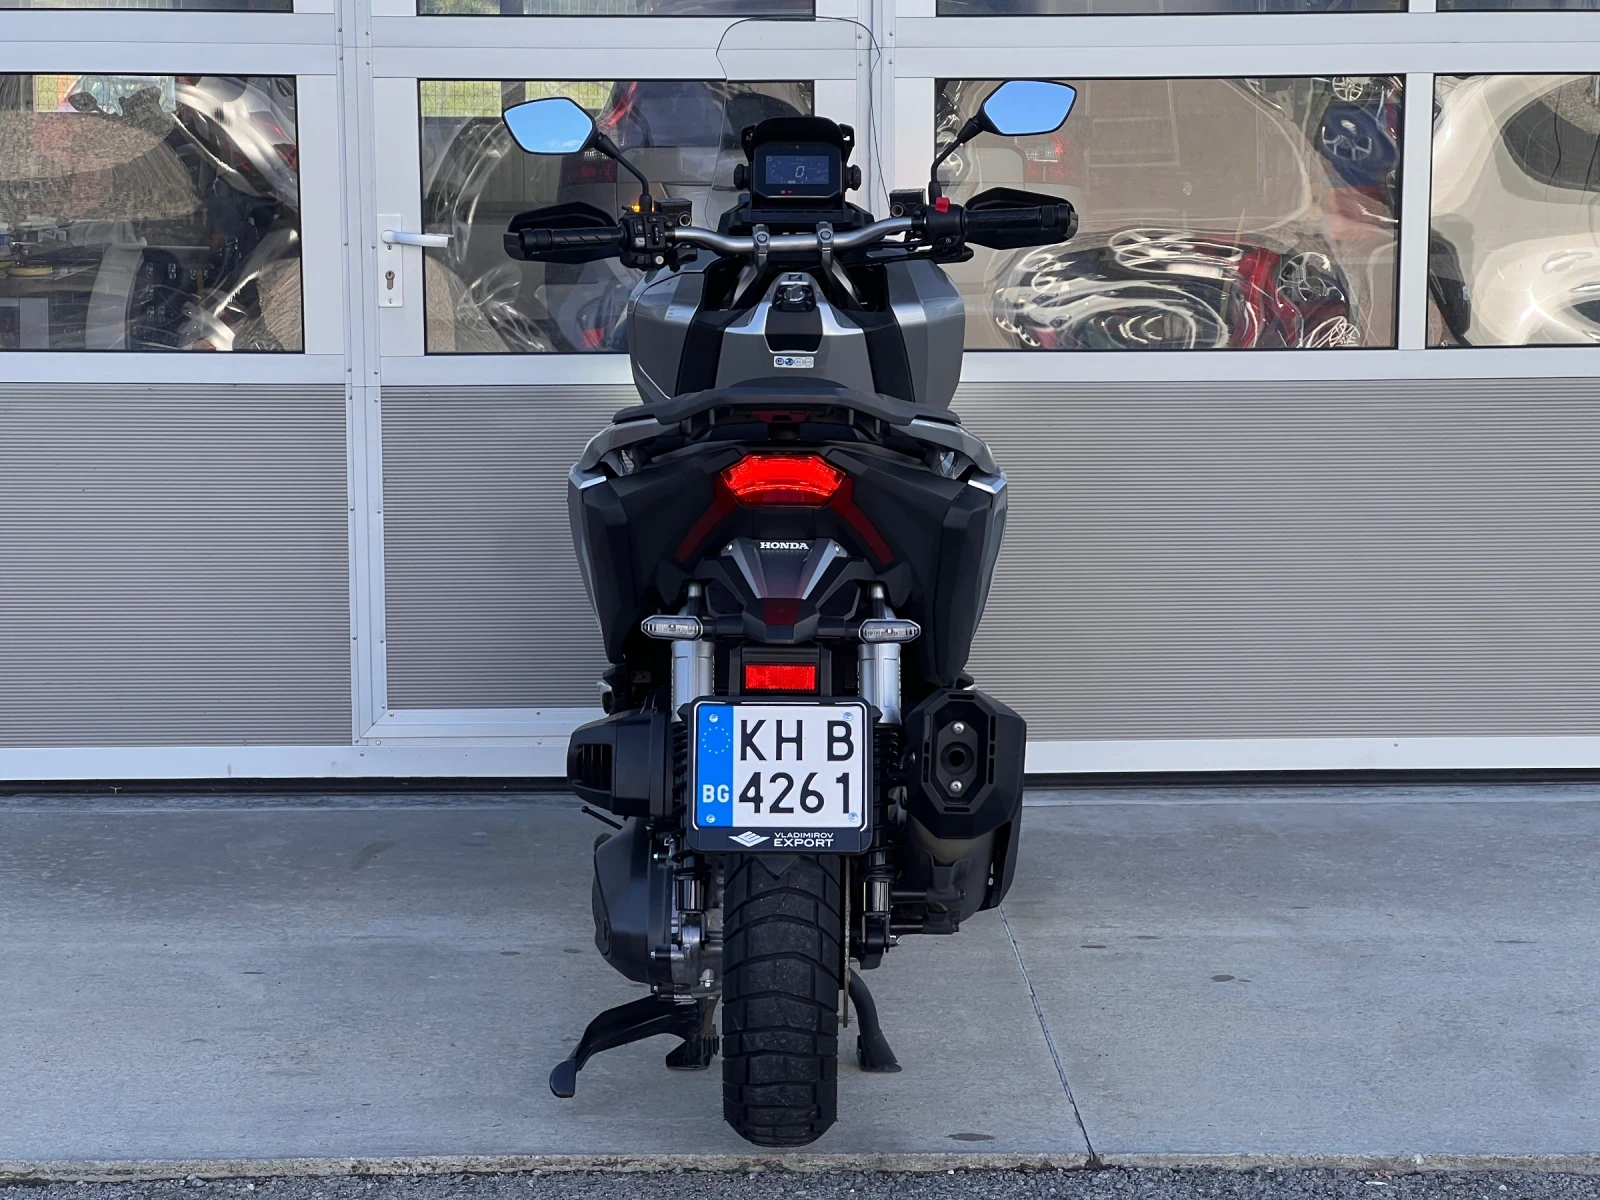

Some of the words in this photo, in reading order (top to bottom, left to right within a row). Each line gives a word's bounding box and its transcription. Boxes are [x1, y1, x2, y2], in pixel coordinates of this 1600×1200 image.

[795, 165, 806, 178] 0
[760, 541, 809, 550] HONDA
[740, 719, 803, 761] KH
[826, 720, 855, 762] B
[702, 784, 730, 803] BG
[738, 771, 850, 814] 4261
[773, 838, 834, 848] EXPORT
